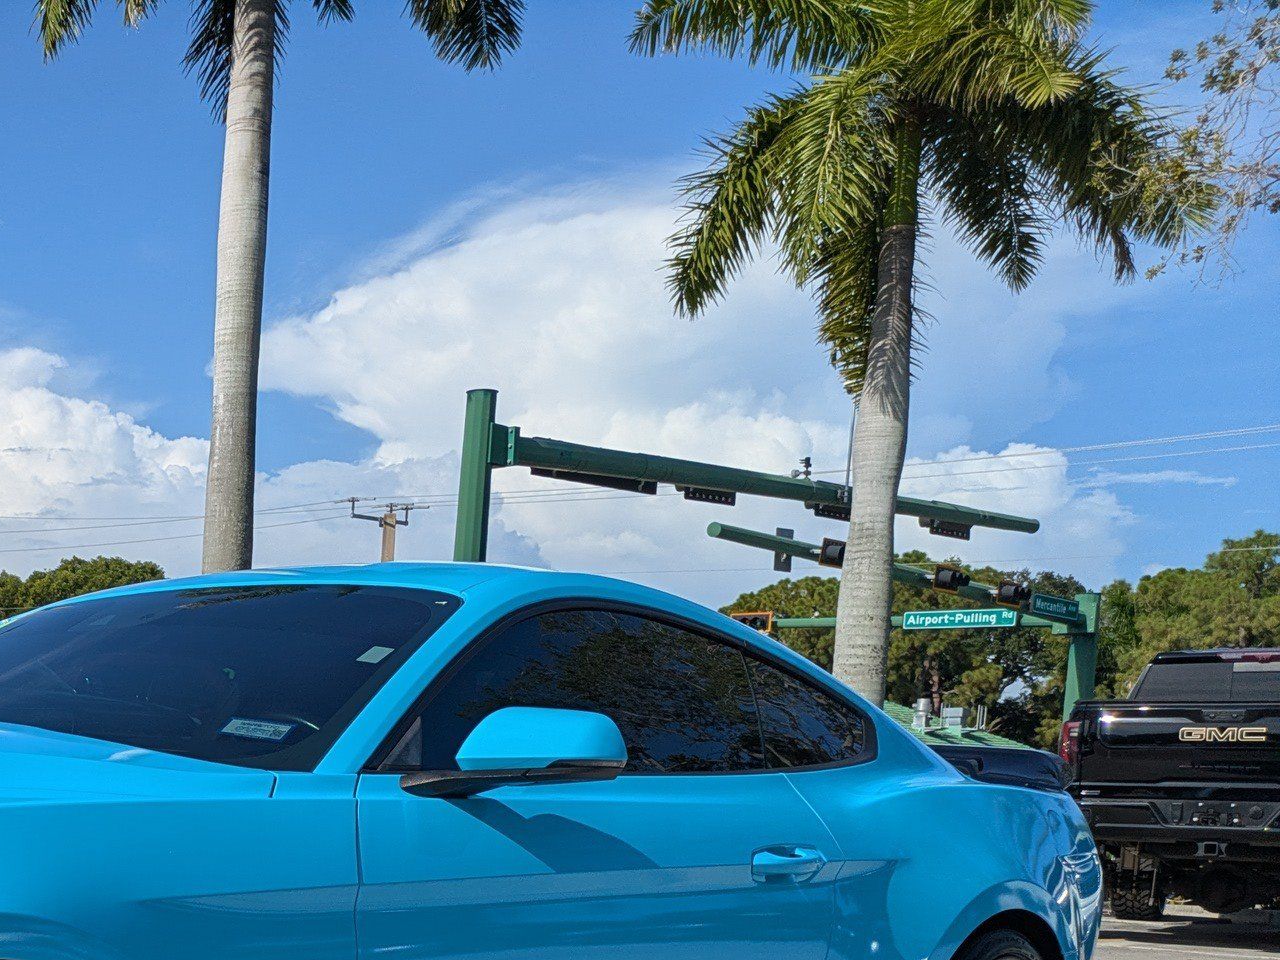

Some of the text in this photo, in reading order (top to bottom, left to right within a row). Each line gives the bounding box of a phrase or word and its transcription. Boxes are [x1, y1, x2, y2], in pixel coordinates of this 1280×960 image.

[1035, 598, 1067, 614] Mercantile
[906, 611, 1013, 626] Airport-Pulling Rd
[1178, 727, 1268, 742] GMC
